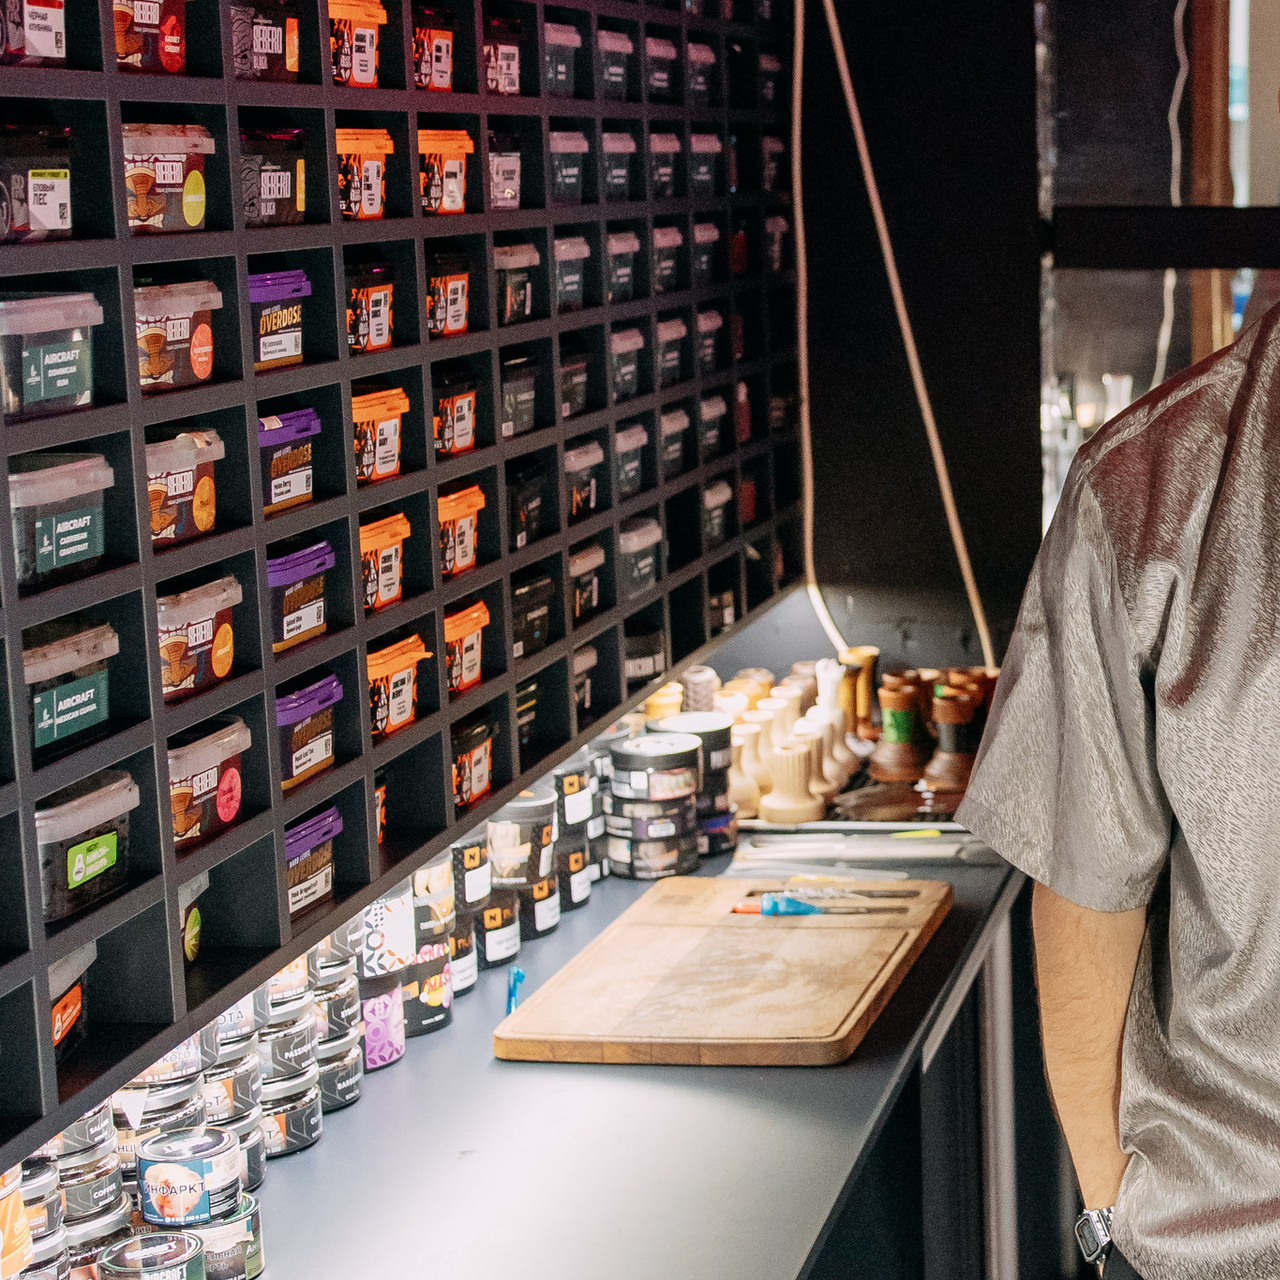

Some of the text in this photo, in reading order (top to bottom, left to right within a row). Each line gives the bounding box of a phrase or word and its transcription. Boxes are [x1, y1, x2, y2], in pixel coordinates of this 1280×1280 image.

[134, 0, 160, 24] SEBERO
[253, 26, 282, 54] SEBERO
[156, 162, 183, 184] SEBERO
[261, 171, 291, 198] SEBERO
[32, 181, 55, 192] ЕЛОВЫЙ
[32, 193, 48, 206] ЛЕС
[260, 304, 302, 335] OVERDOSE
[44, 350, 80, 364] AIRCRAFT
[271, 443, 312, 478] OVERDOSE
[167, 471, 193, 496] SEBERO
[56, 516, 91, 534] AIRCRAFT
[188, 620, 213, 648] SEBERO
[57, 688, 95, 713] AIRCRAFT
[93, 1182, 117, 1199] COFFEE
[144, 1180, 205, 1195] ИНФАРКТ
